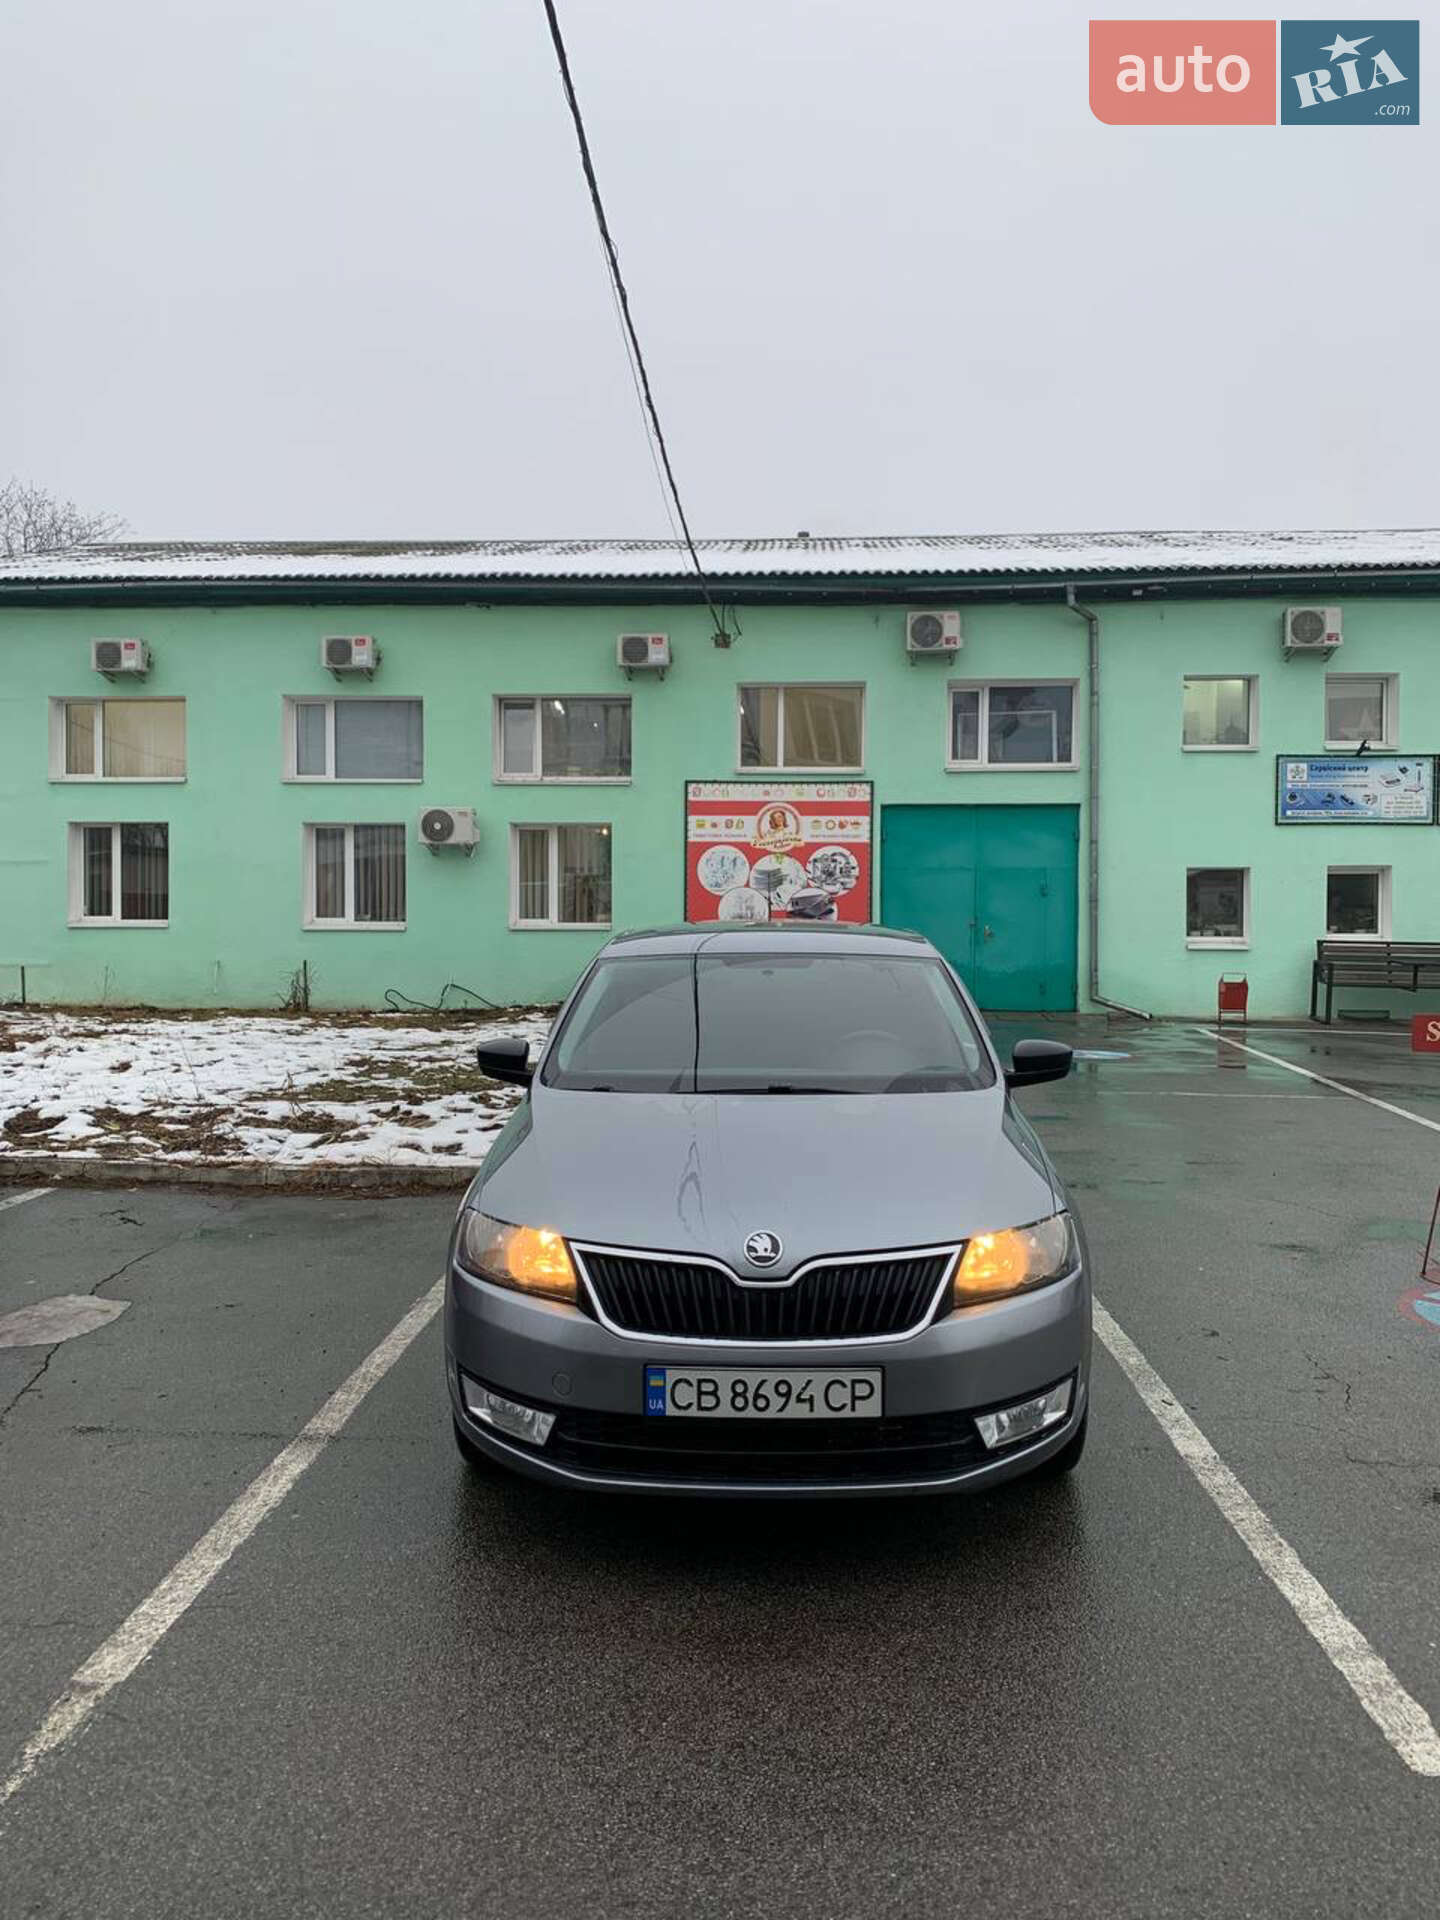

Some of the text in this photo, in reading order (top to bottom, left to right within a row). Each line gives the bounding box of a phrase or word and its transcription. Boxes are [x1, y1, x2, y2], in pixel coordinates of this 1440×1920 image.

[648, 1399, 665, 1410] UA
[669, 1377, 876, 1413] CB 8694 CP
